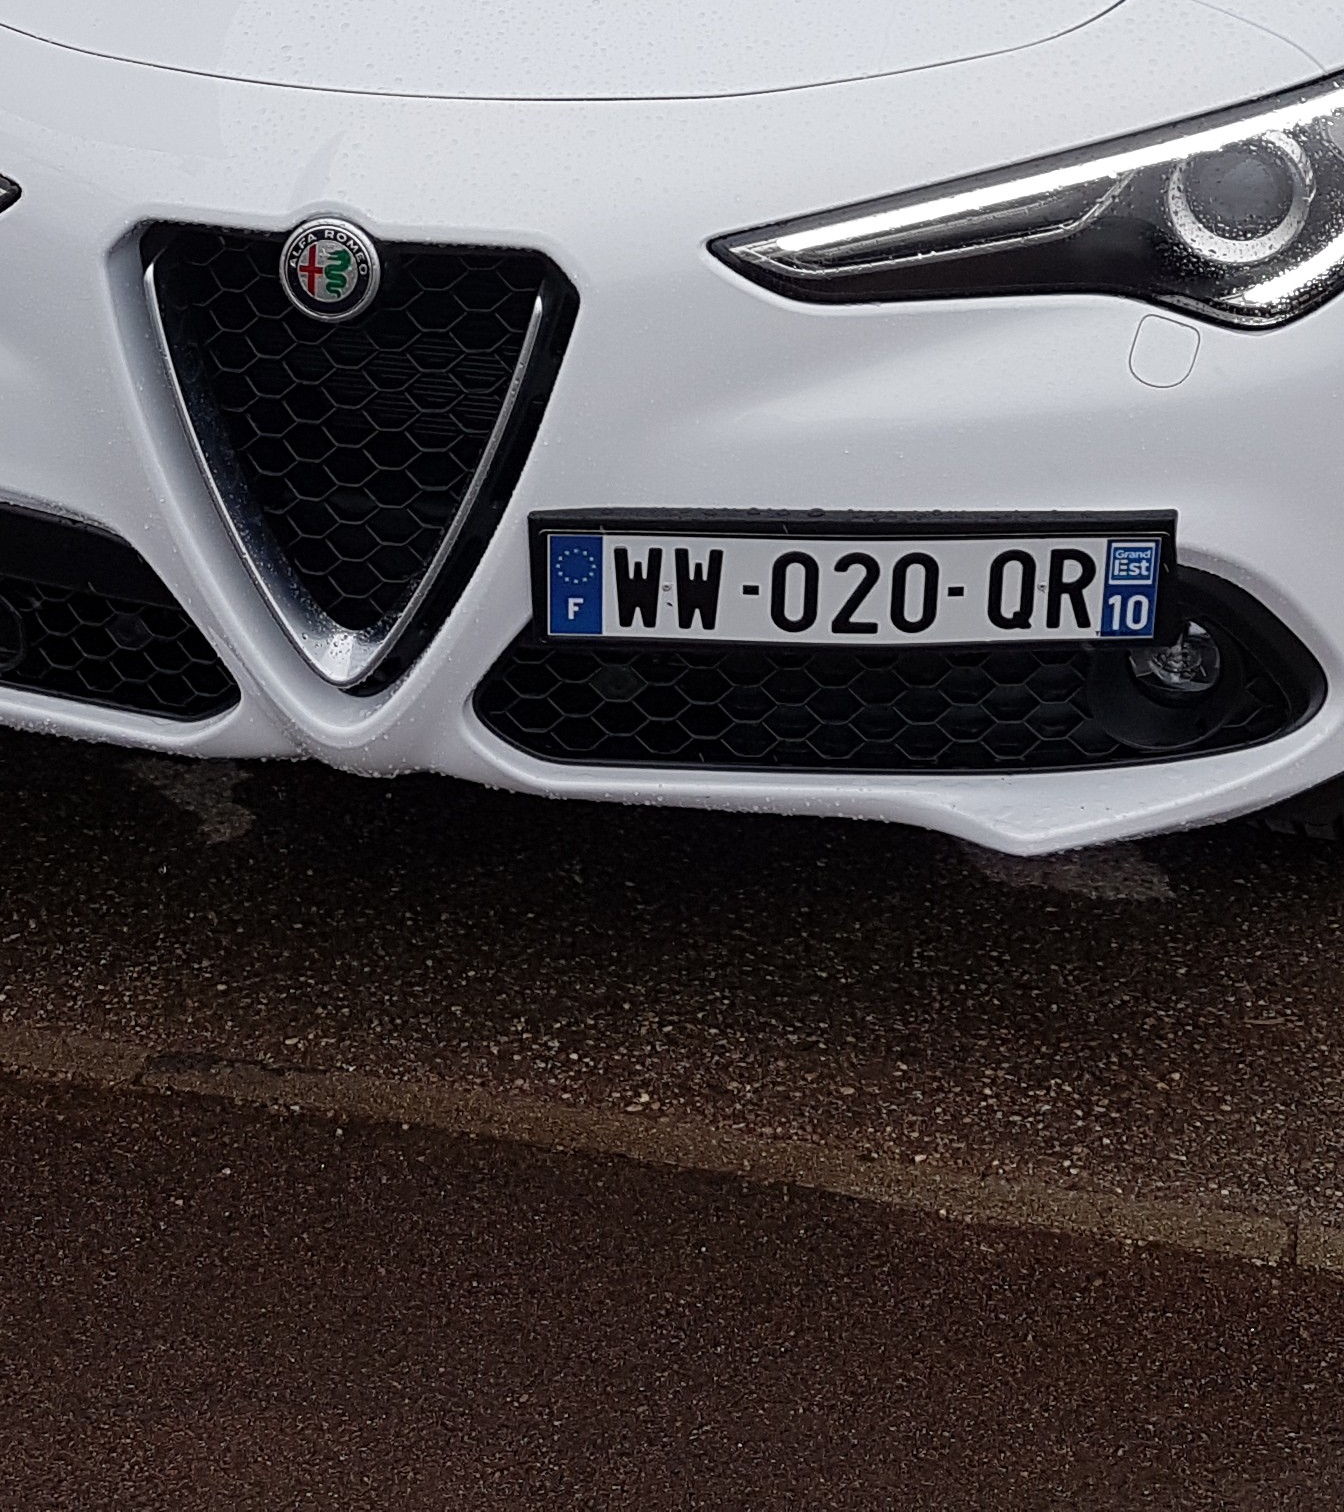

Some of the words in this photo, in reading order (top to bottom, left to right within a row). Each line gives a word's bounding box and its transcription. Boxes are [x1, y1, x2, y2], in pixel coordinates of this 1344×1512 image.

[289, 233, 318, 268] ALFA
[324, 229, 368, 275] ROMEO
[1115, 549, 1151, 559] Grand
[1113, 559, 1150, 576] Est
[567, 597, 584, 620] F
[1108, 594, 1150, 630] 10
